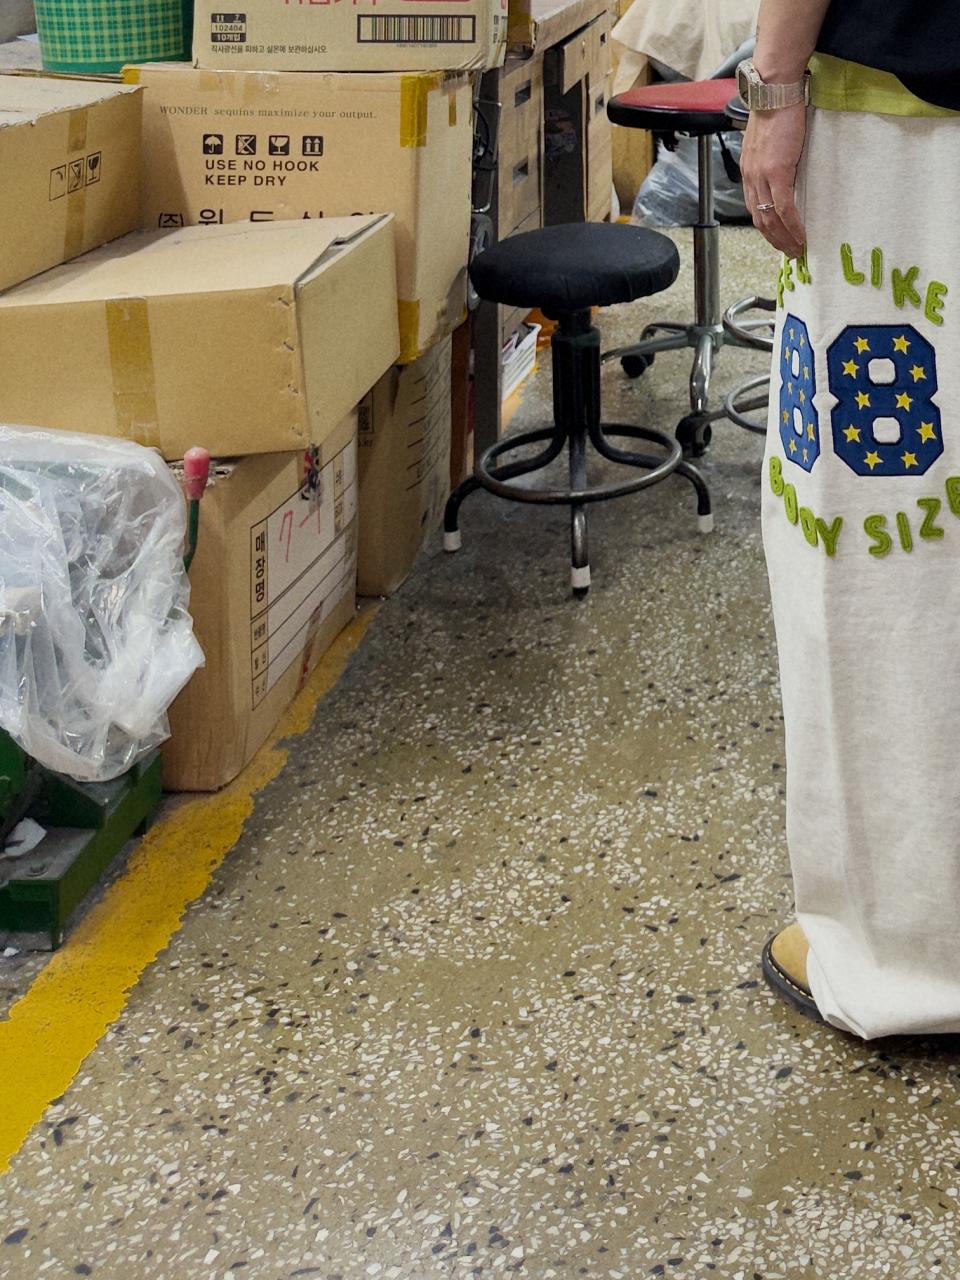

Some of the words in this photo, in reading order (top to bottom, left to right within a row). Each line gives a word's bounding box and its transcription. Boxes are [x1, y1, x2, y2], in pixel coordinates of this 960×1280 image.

[159, 105, 208, 116] WONDER
[214, 107, 254, 118] sequins
[258, 107, 310, 117] maximize
[312, 109, 336, 119] your
[205, 160, 237, 170] USE
[243, 160, 266, 170] NO
[273, 160, 320, 171] HOOK
[205, 175, 247, 185] KEEP
[254, 175, 287, 186] DRY
[840, 242, 948, 326] LIKE
[769, 455, 843, 557] BODY
